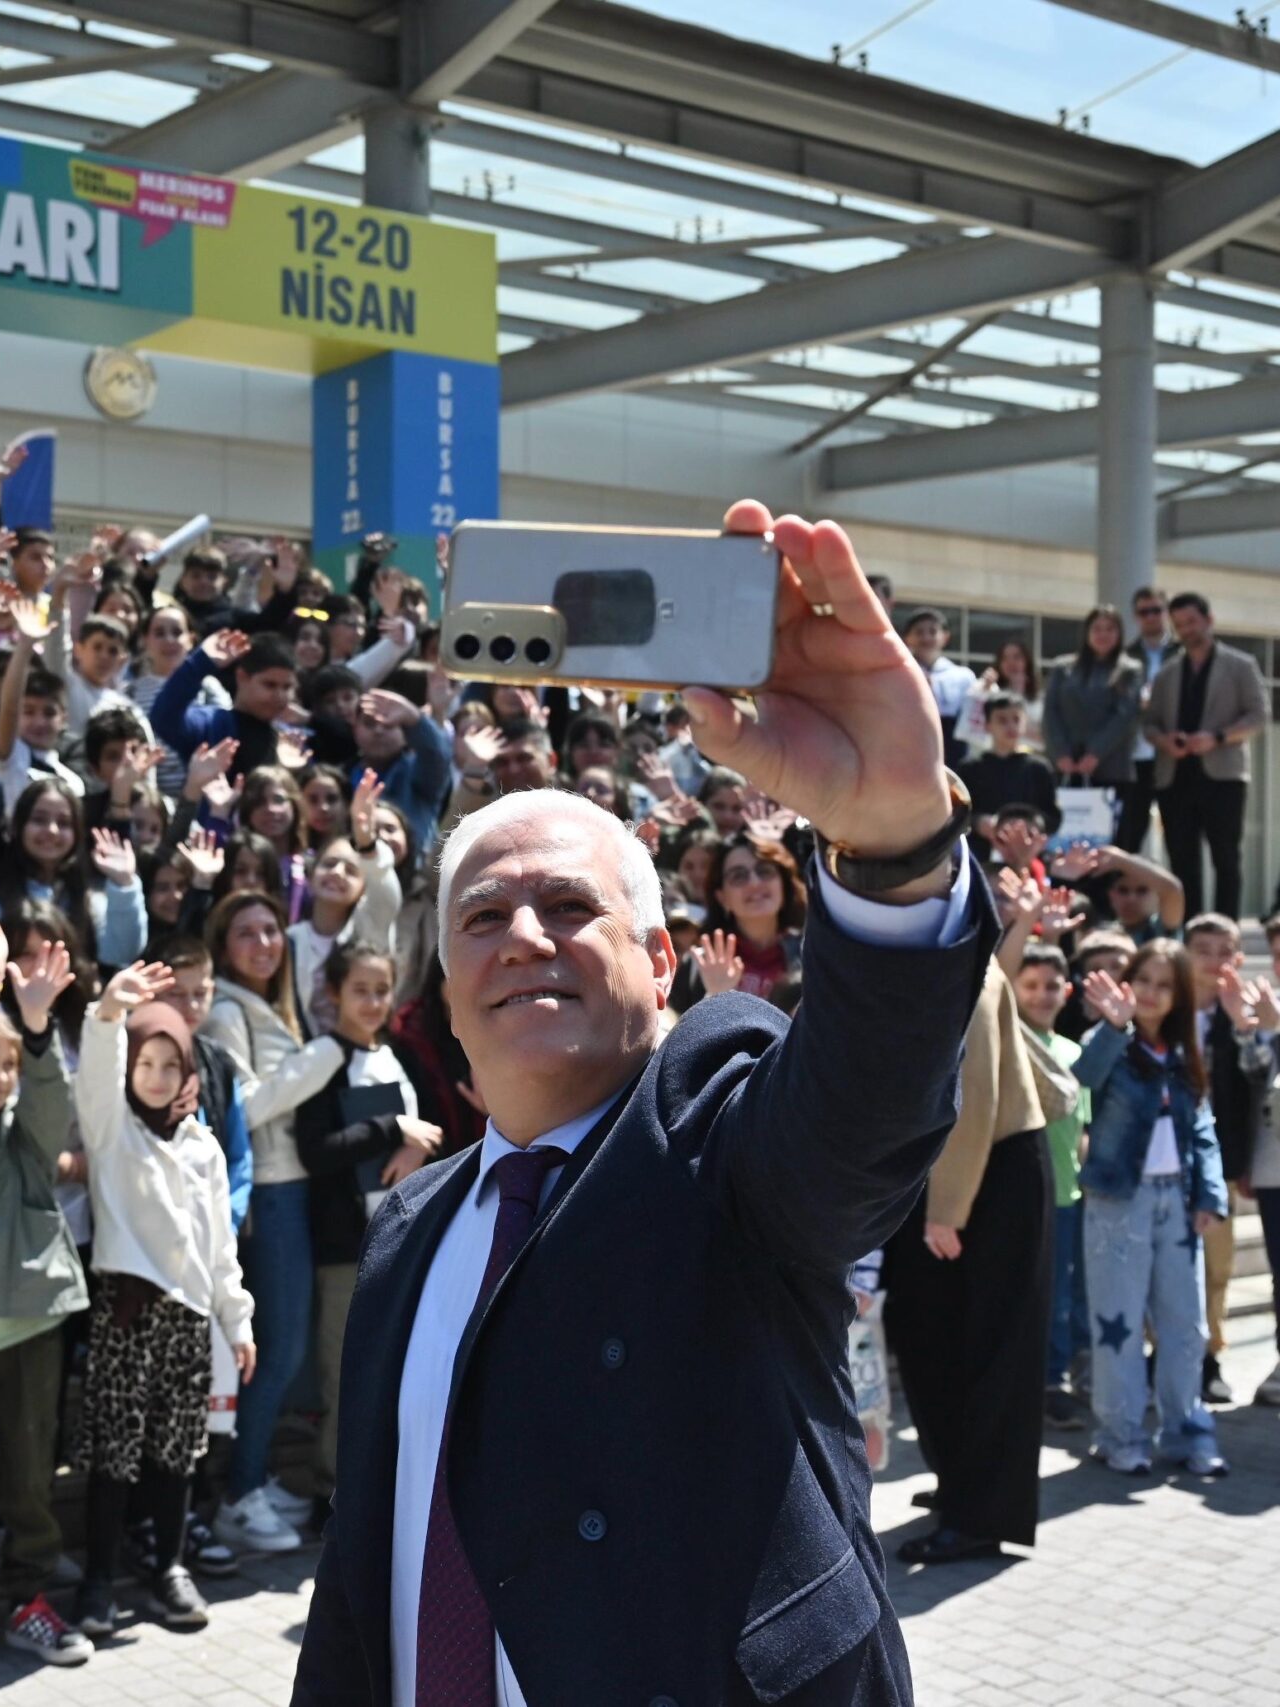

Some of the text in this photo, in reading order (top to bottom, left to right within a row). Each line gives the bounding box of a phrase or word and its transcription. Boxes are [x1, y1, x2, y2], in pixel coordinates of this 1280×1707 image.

[286, 205, 410, 272] 12-20
[280, 264, 416, 336] NİSAN
[438, 371, 453, 497] BURSA
